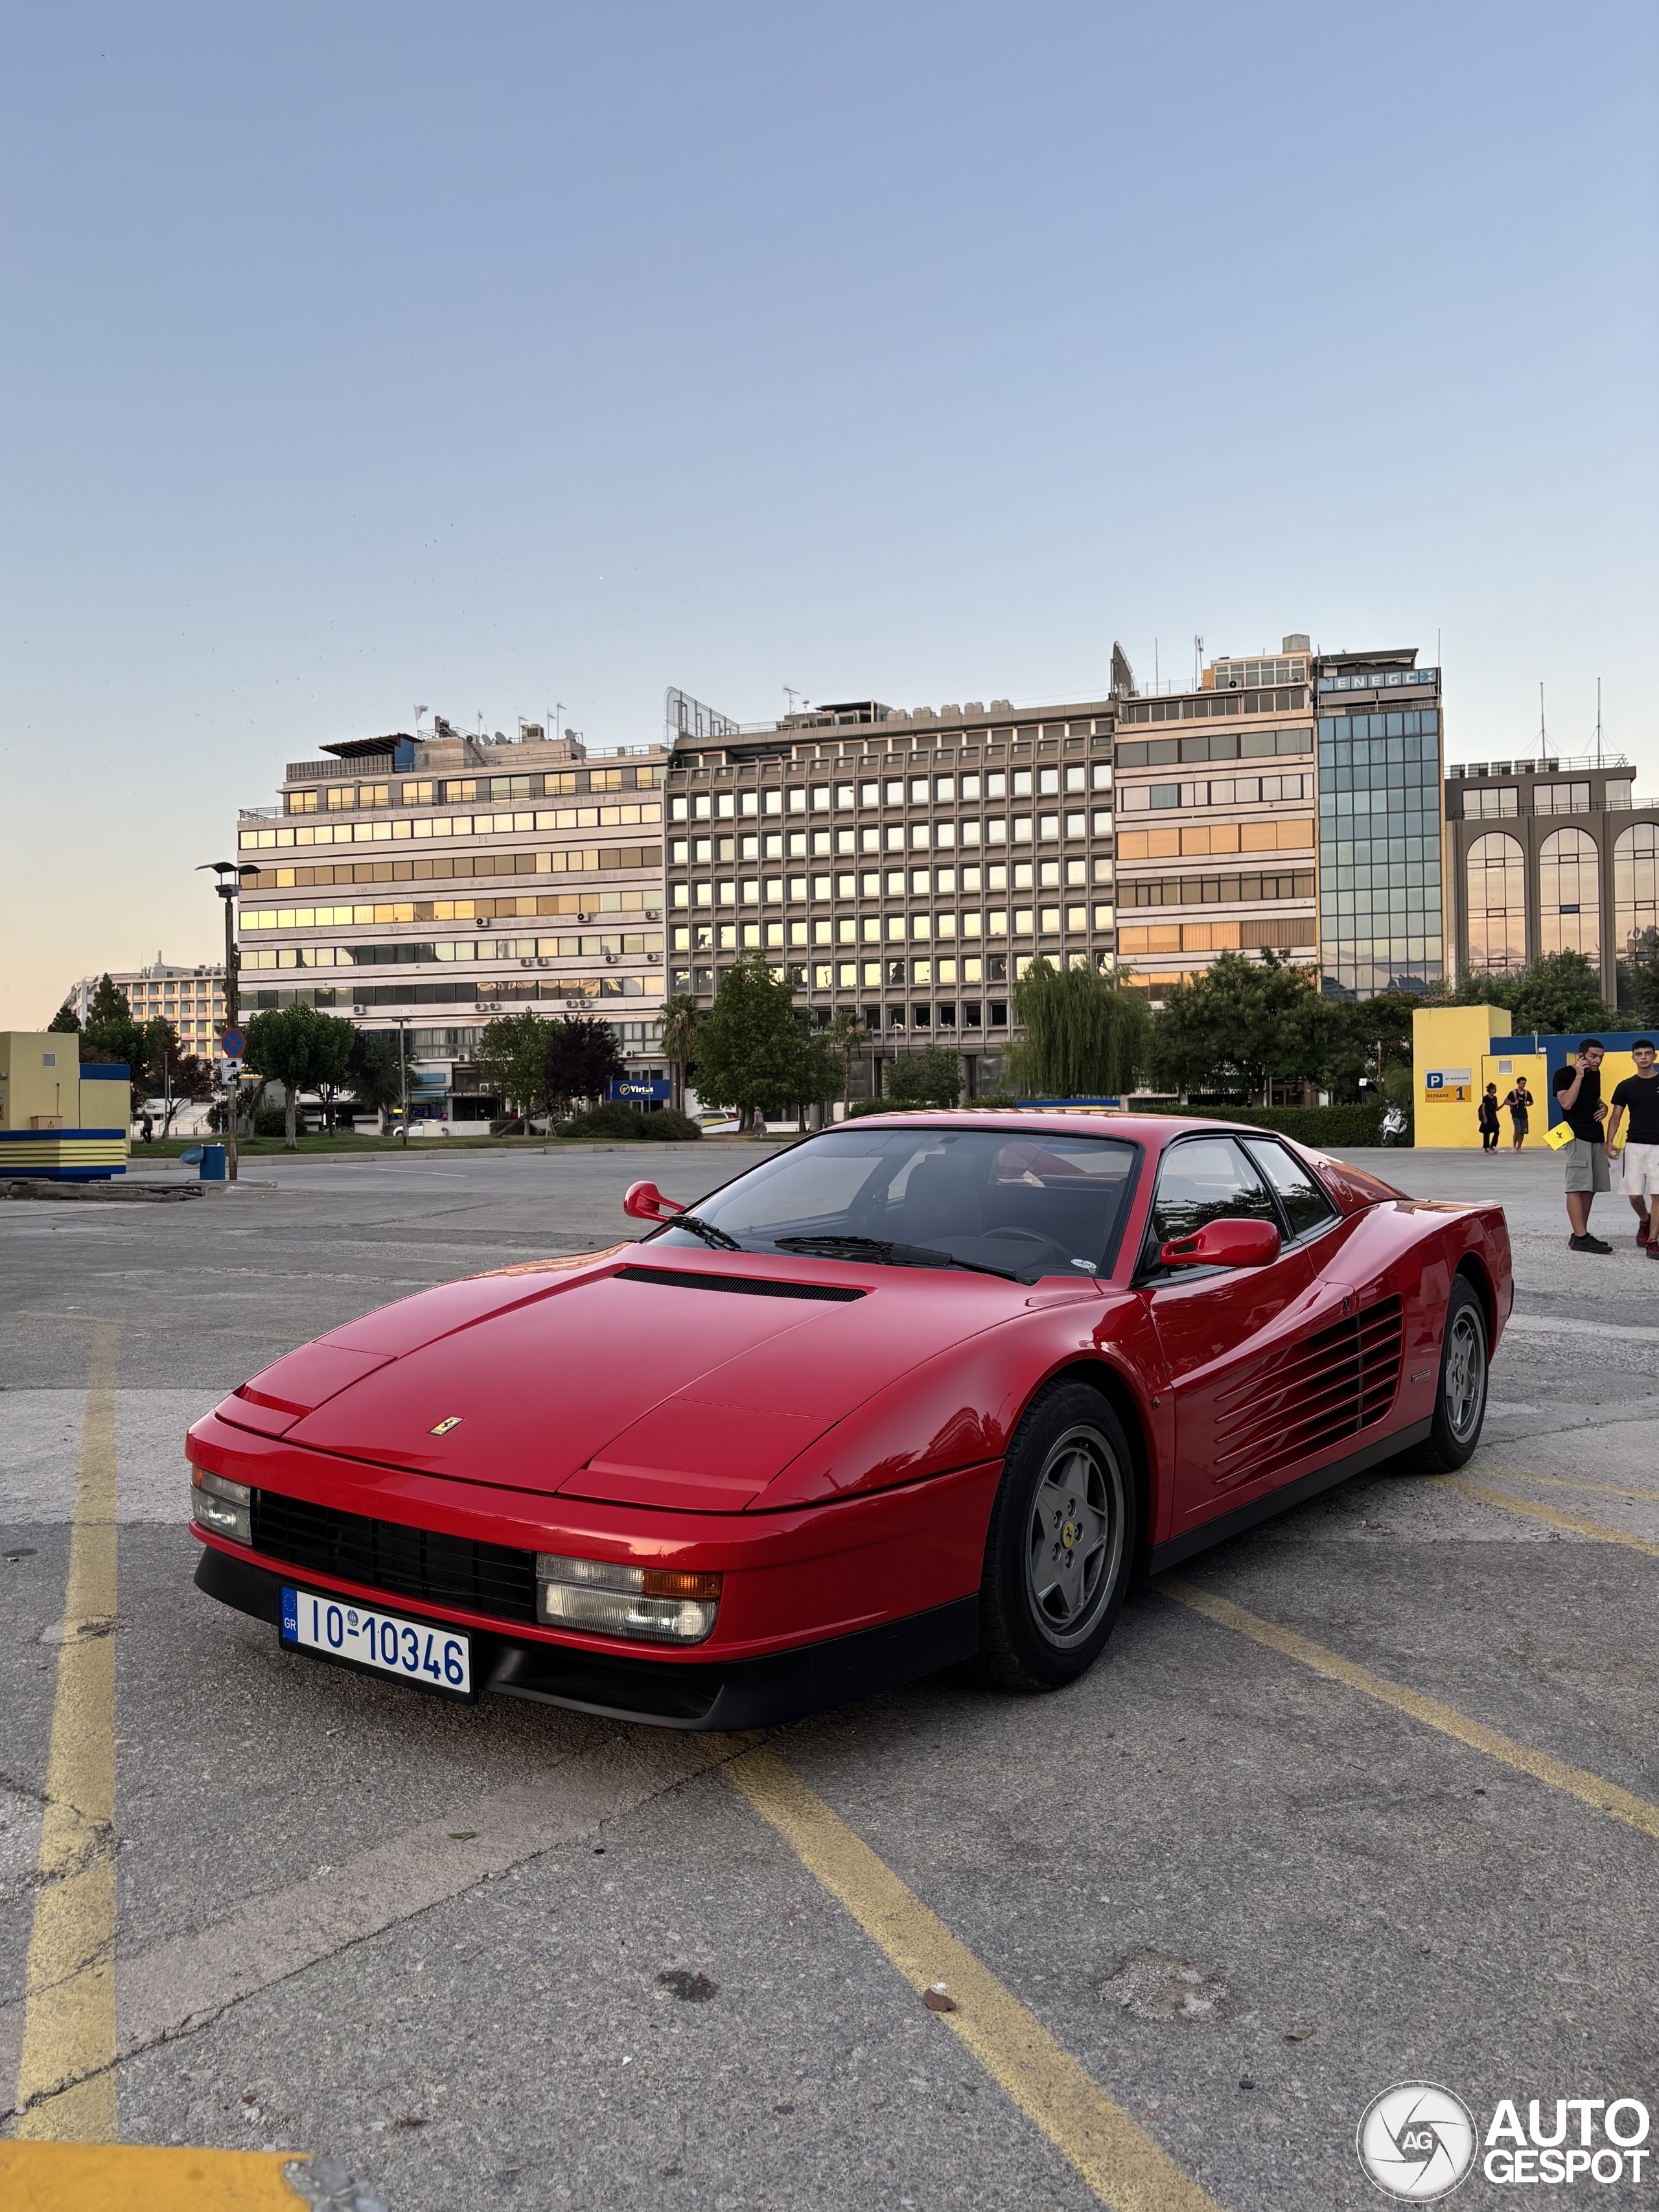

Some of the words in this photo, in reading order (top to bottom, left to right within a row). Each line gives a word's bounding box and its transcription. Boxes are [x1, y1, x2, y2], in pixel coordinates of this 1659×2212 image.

[1430, 1075, 1440, 1087] P
[1456, 1086, 1465, 1100] 1
[284, 1617, 297, 1631] GR
